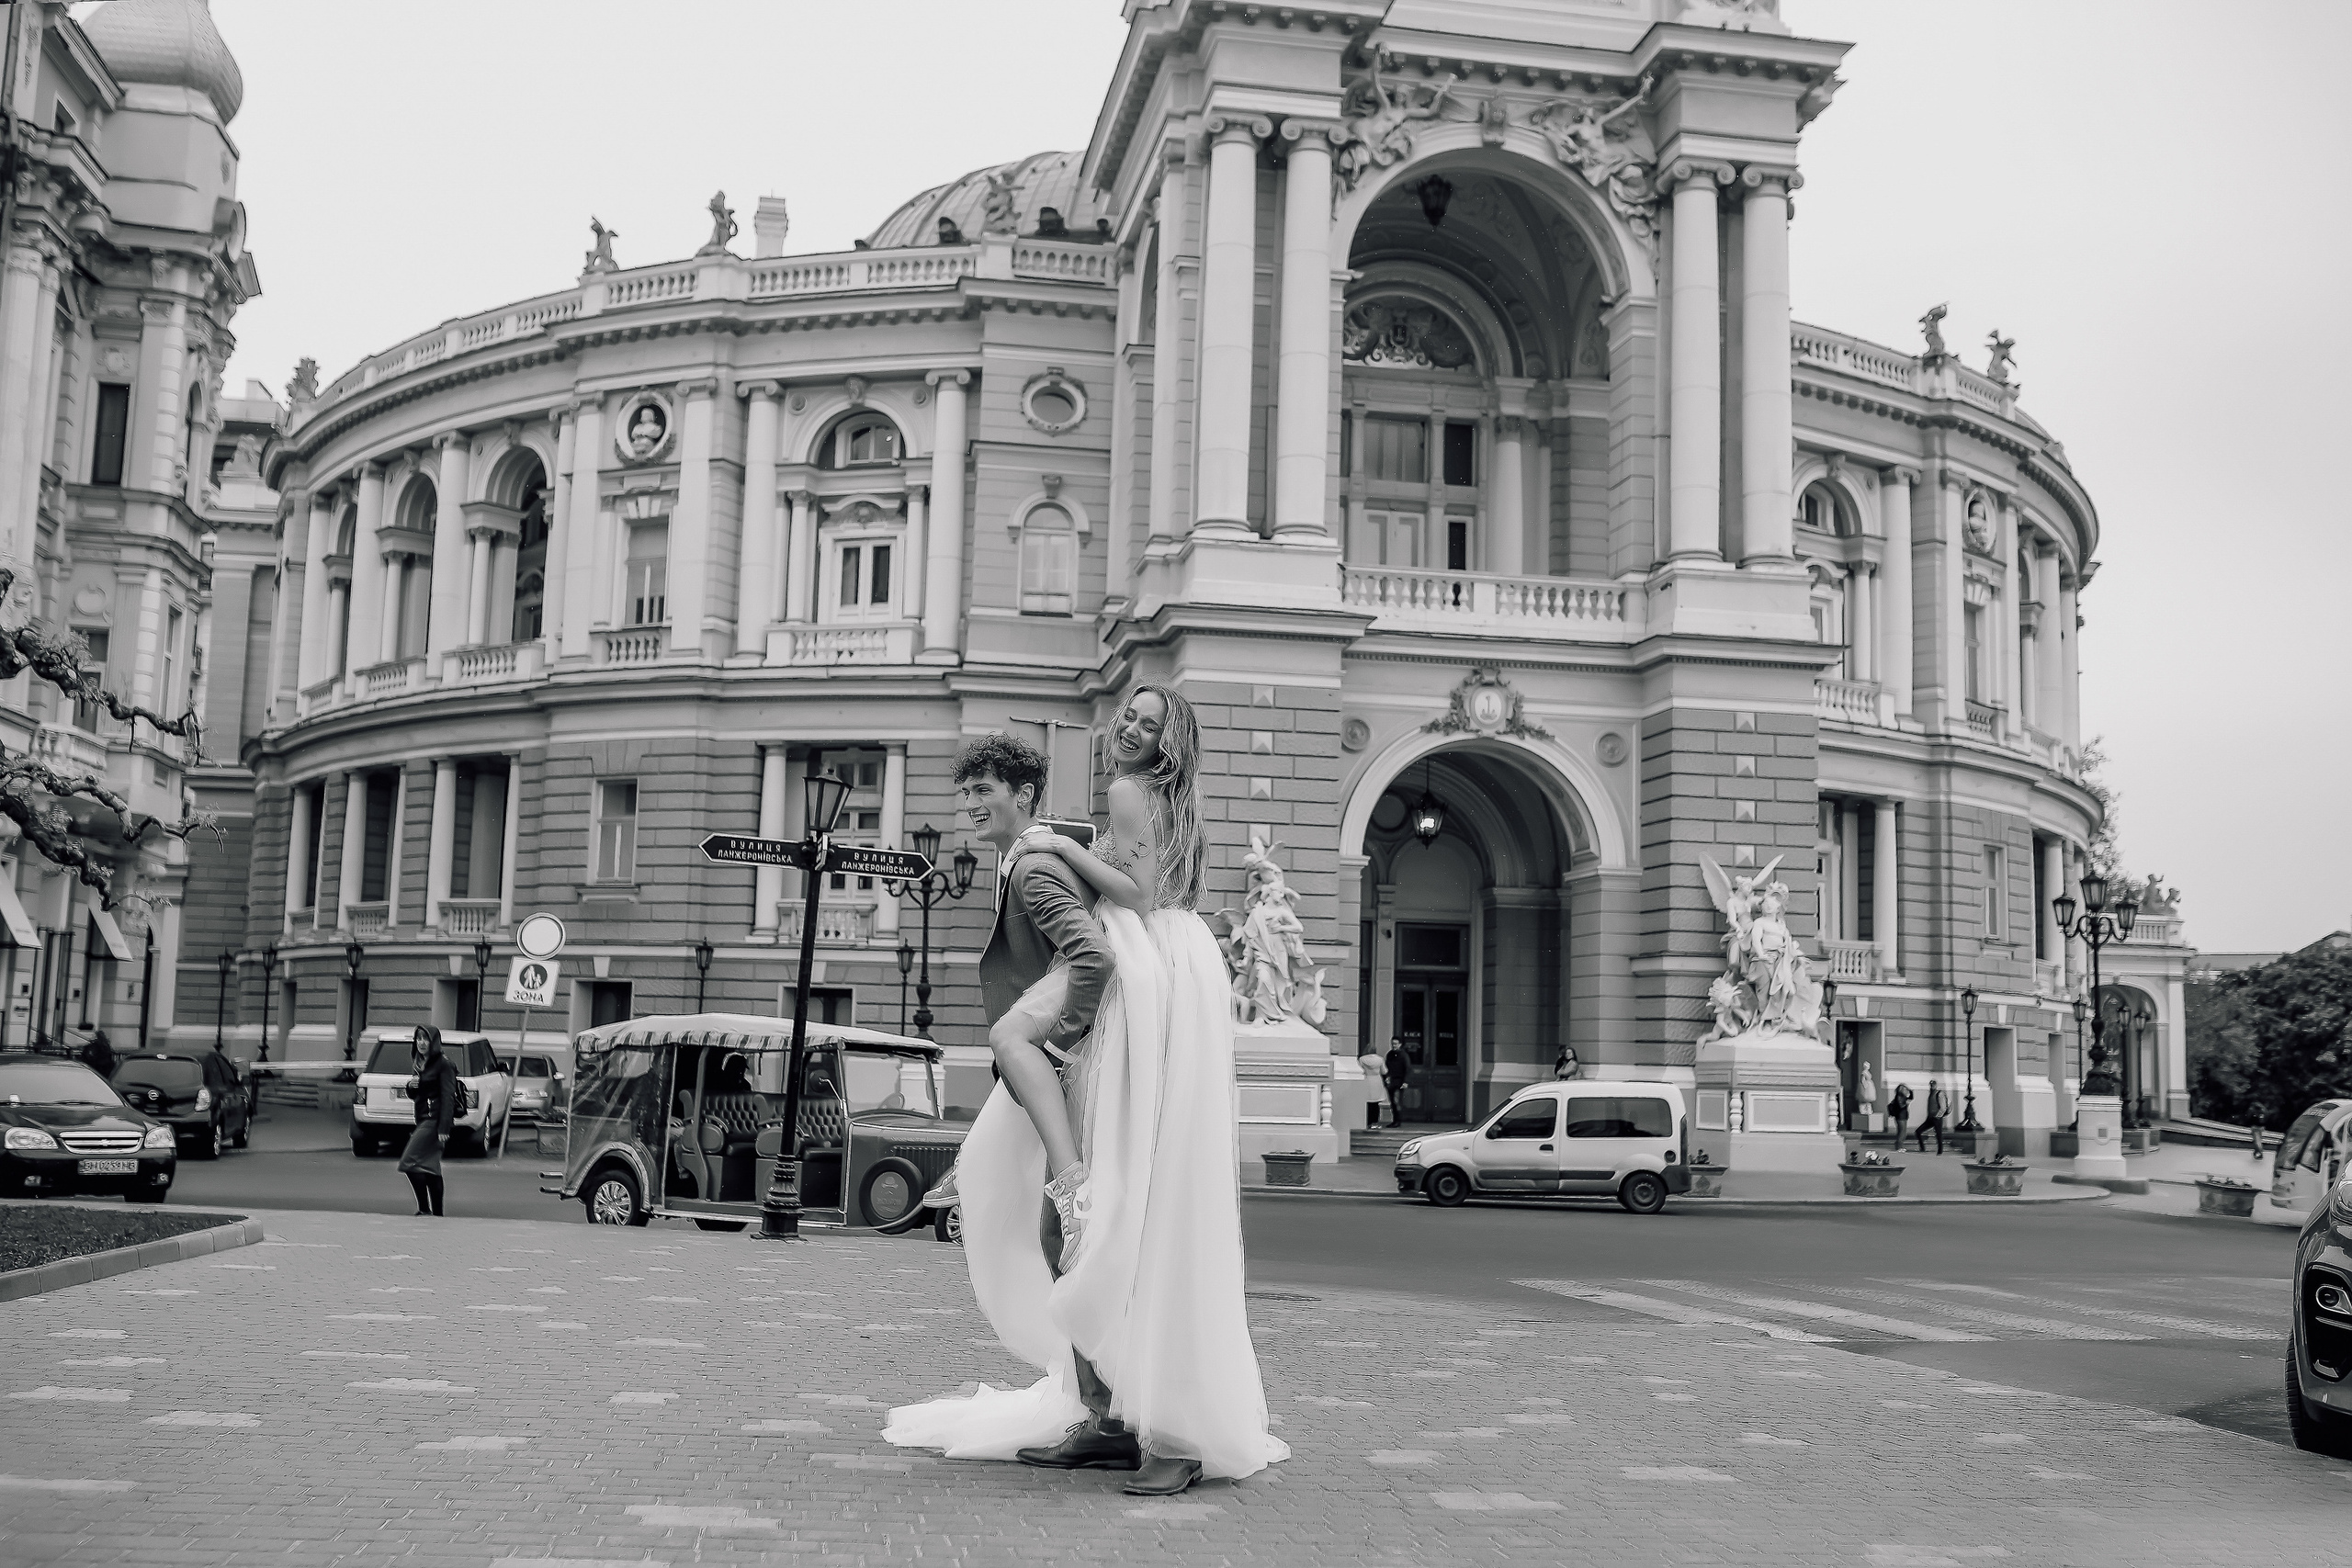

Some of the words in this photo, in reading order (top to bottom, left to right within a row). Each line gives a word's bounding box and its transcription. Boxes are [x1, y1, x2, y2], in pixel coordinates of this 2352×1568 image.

[730, 840, 781, 852] ВУЛИЦЯ
[718, 849, 793, 863] ЛАНЖЕРОНІВСЬКА
[854, 852, 904, 865] ВУЛИЦЯ
[841, 861, 915, 875] ЛАНЖЕРОНІВСЬКА
[513, 990, 544, 1004] ЗОНА
